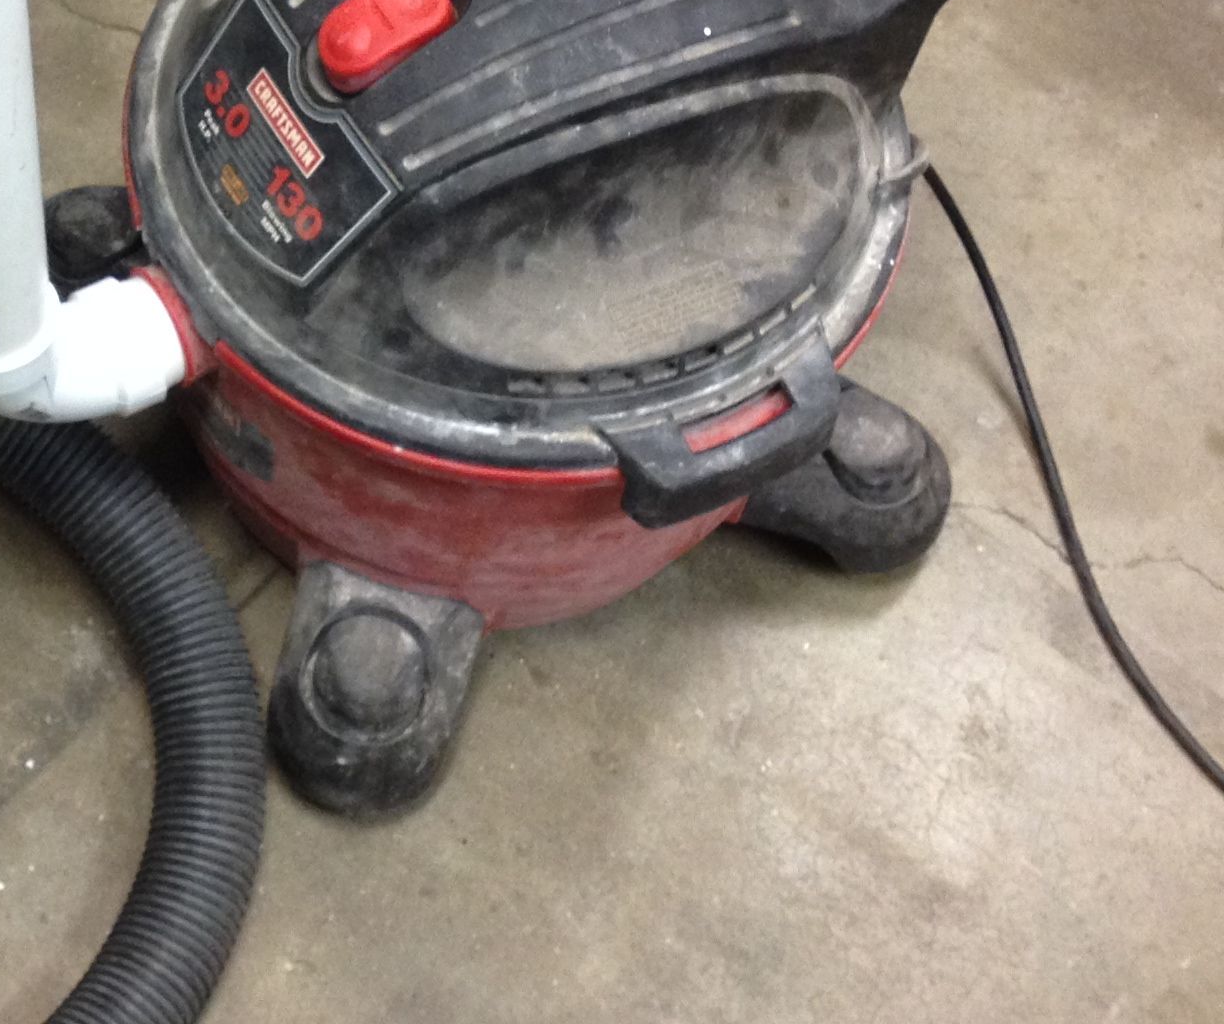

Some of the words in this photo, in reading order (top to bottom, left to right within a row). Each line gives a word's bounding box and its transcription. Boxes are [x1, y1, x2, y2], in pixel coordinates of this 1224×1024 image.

[205, 70, 251, 137] 3.0
[254, 80, 316, 166] CRAFTSMAN
[267, 166, 323, 240] 130
